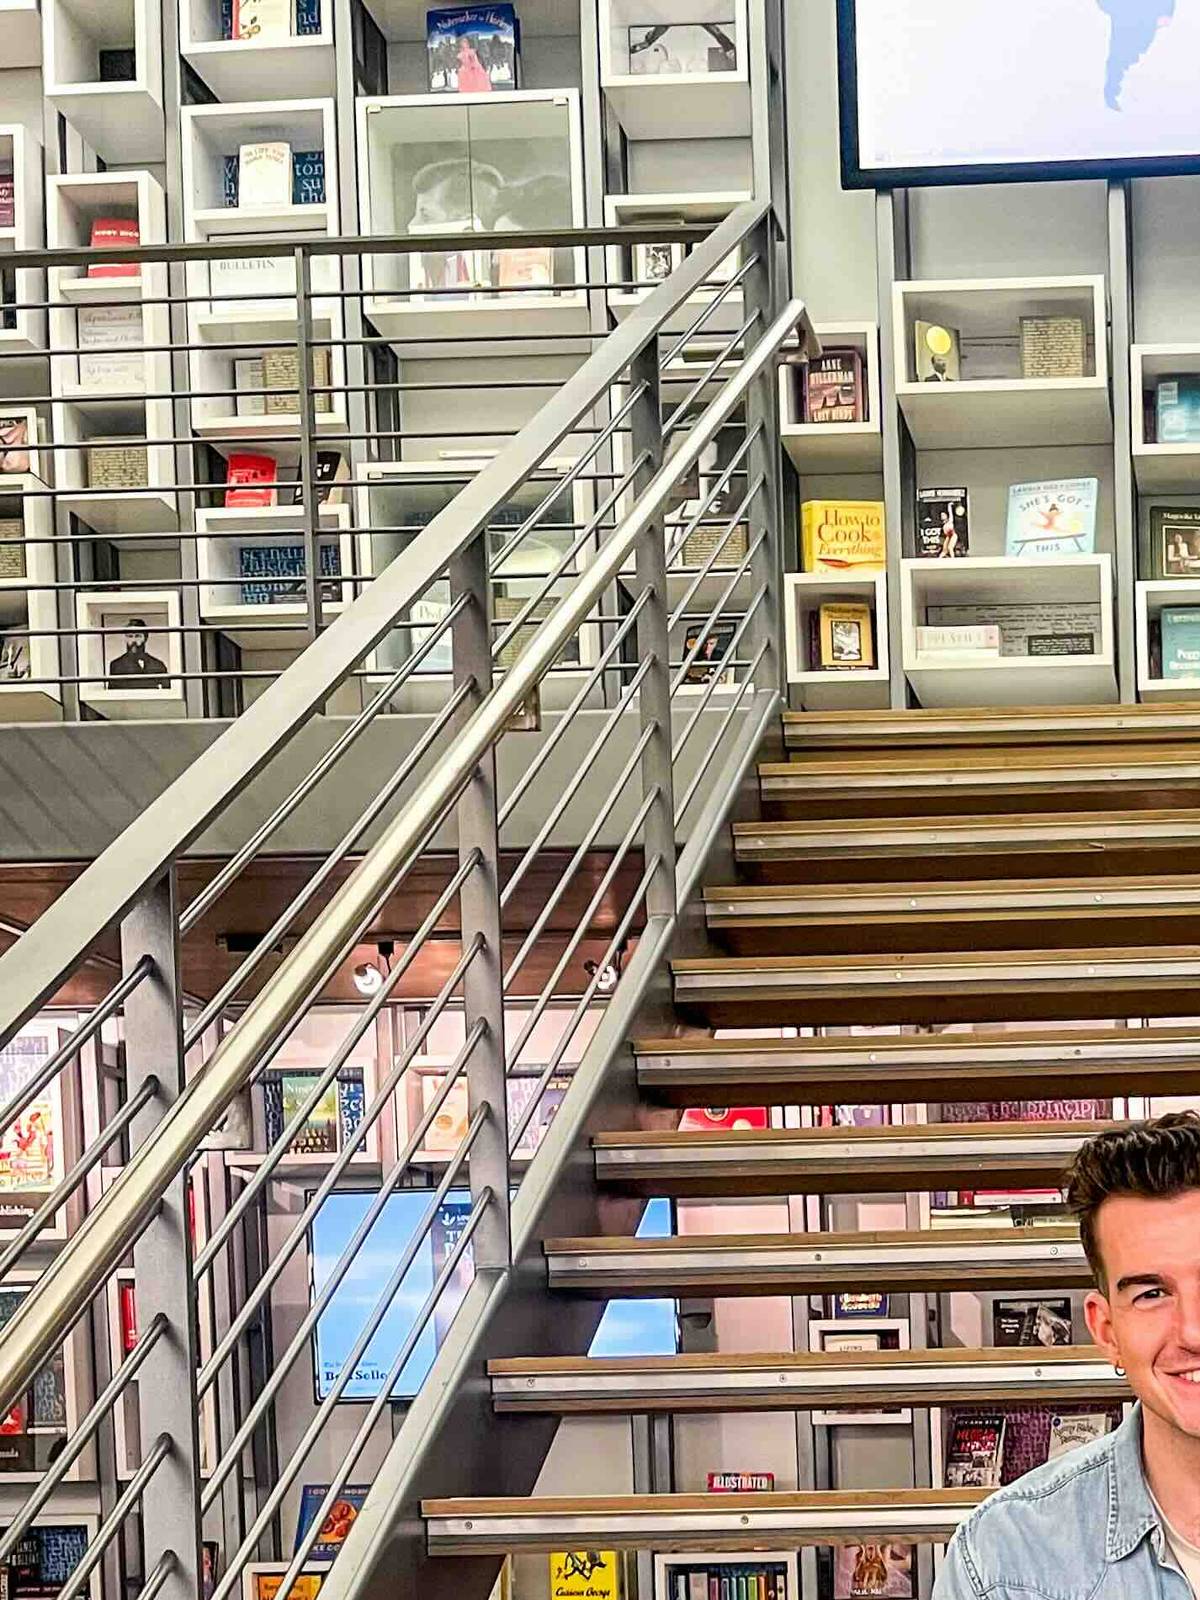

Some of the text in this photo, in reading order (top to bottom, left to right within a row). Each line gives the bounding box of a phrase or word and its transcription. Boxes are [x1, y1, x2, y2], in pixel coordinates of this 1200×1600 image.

[219, 258, 276, 271] BULLETIN
[824, 509, 880, 526] How to
[817, 523, 872, 544] Cook
[818, 542, 882, 557] Everything
[1036, 543, 1061, 552] THIS
[713, 1476, 768, 1488] ILLUSTRATED
[555, 1587, 611, 1599] Curious George
